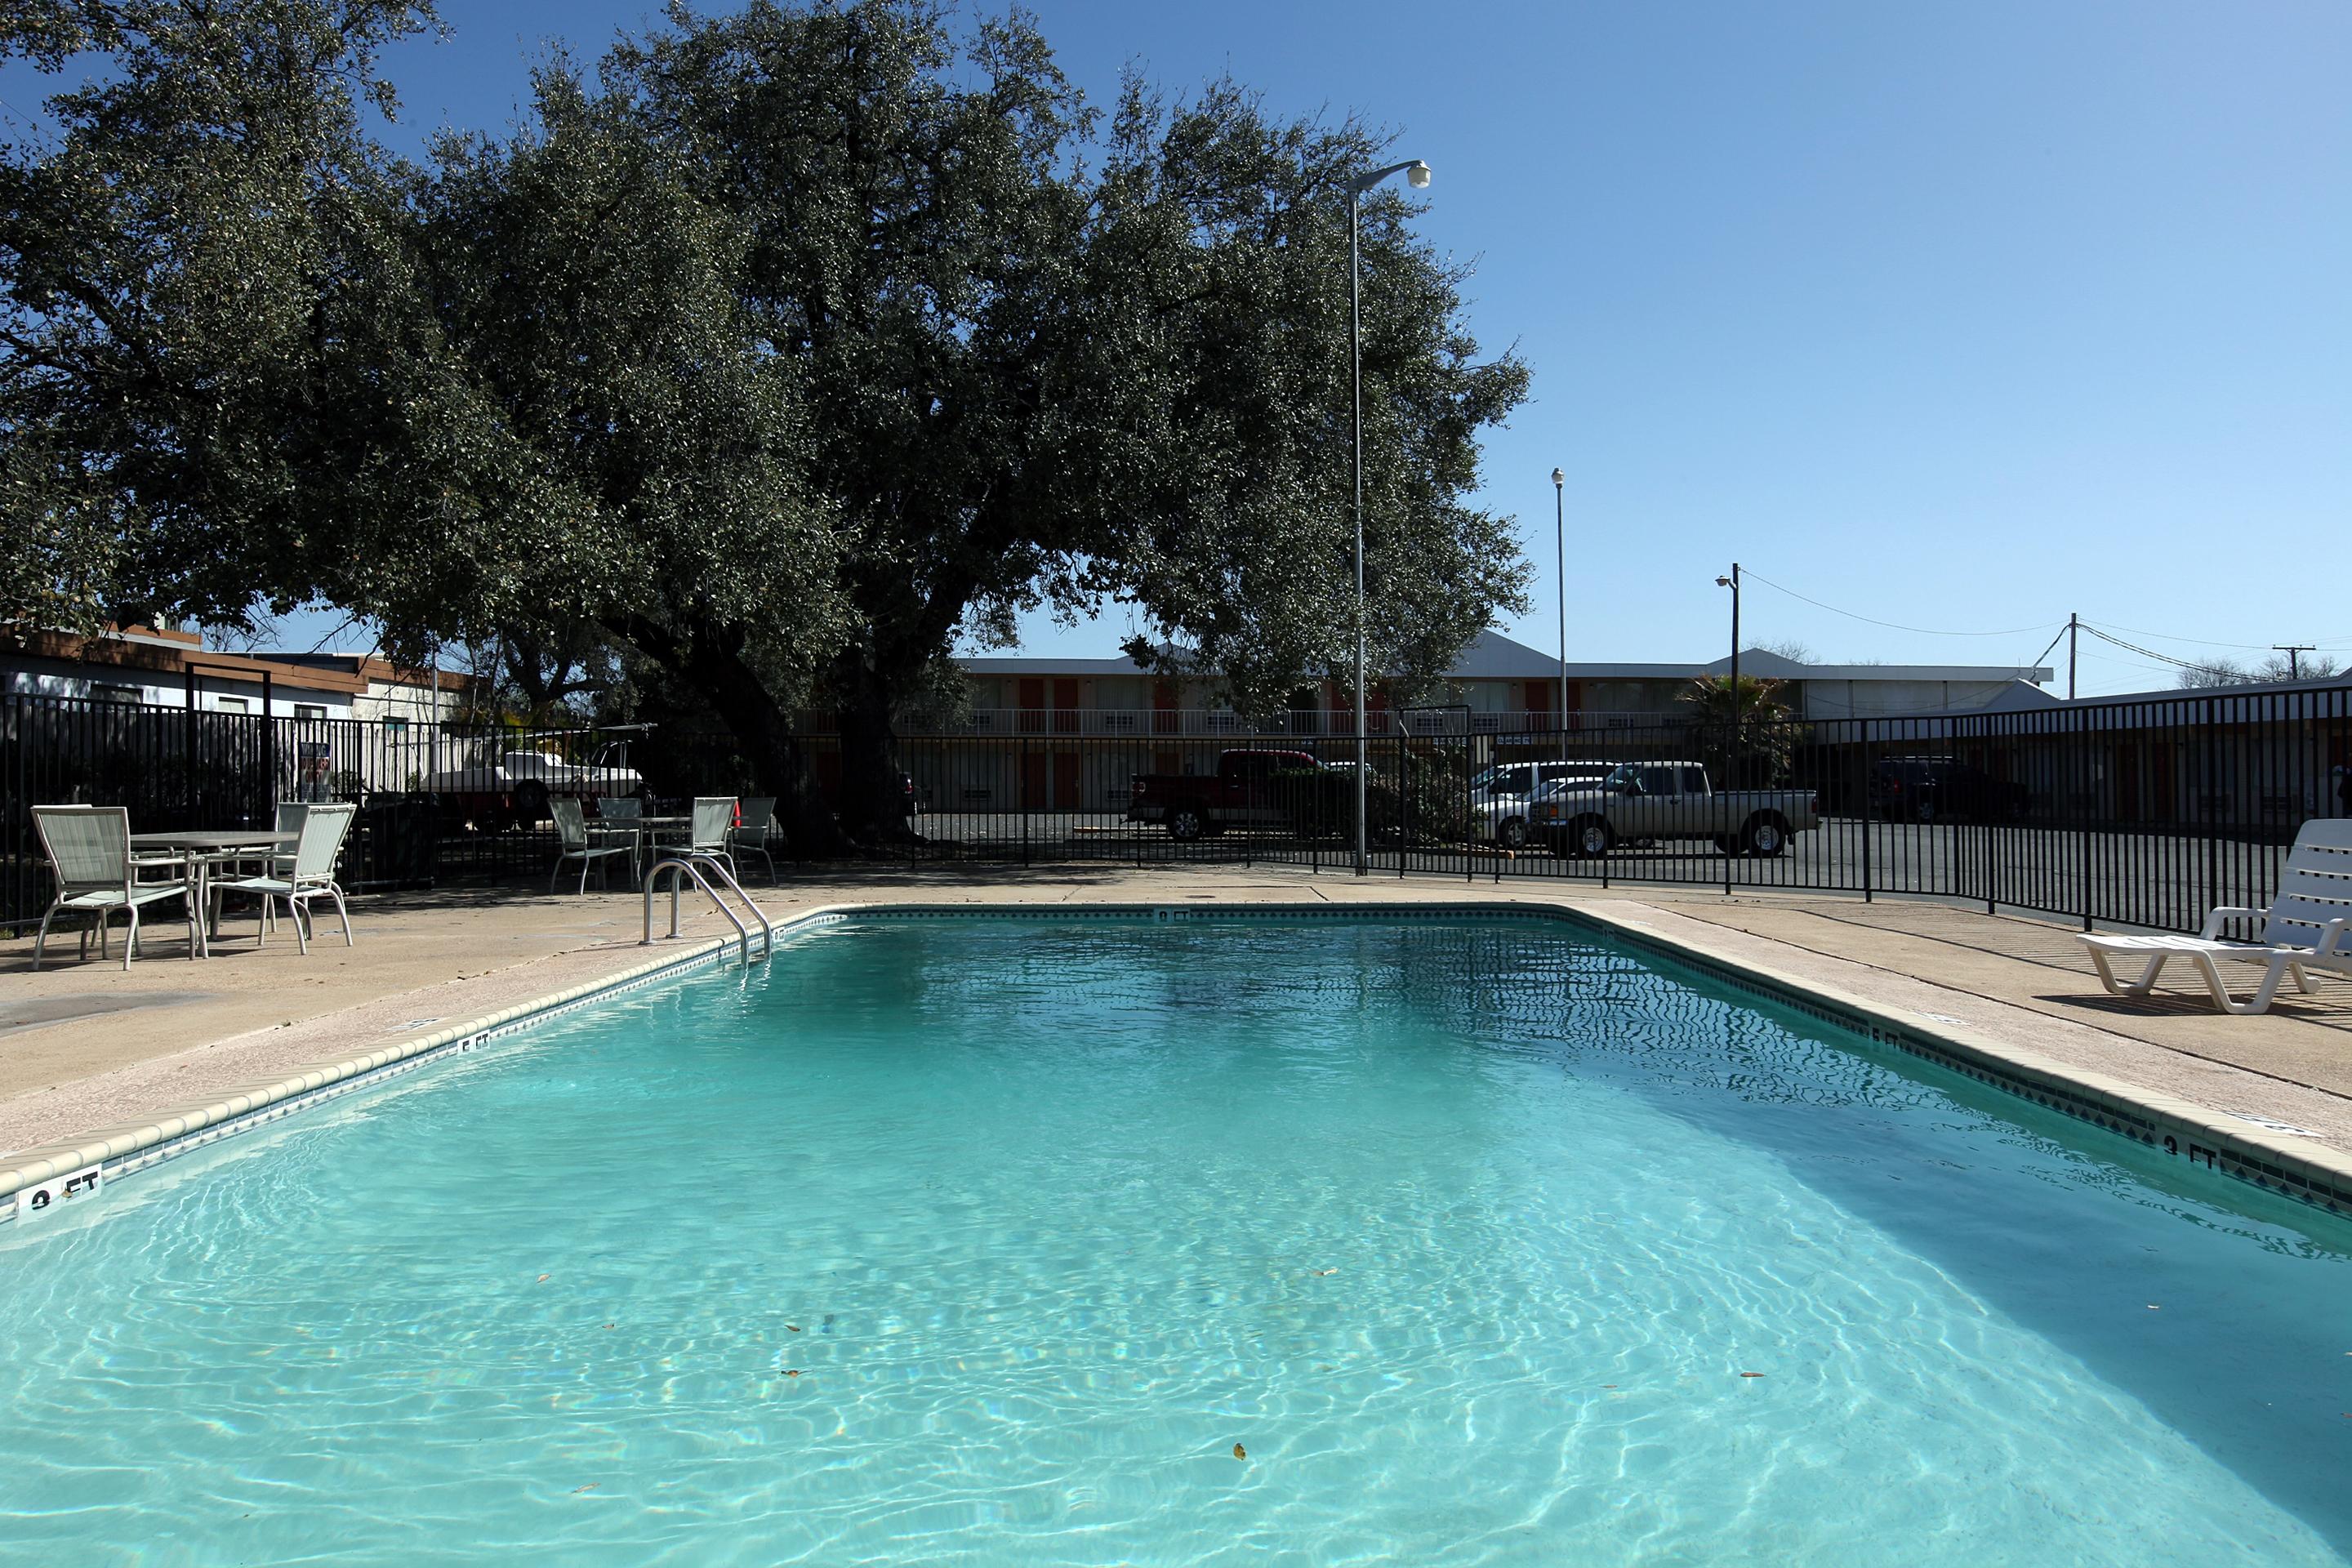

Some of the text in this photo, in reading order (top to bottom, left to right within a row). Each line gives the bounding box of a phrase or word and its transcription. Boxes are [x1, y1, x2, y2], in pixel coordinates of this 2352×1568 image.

[1885, 1031, 1899, 1049] FT
[2189, 1143, 2216, 1169] FT
[66, 1170, 98, 1196] FT
